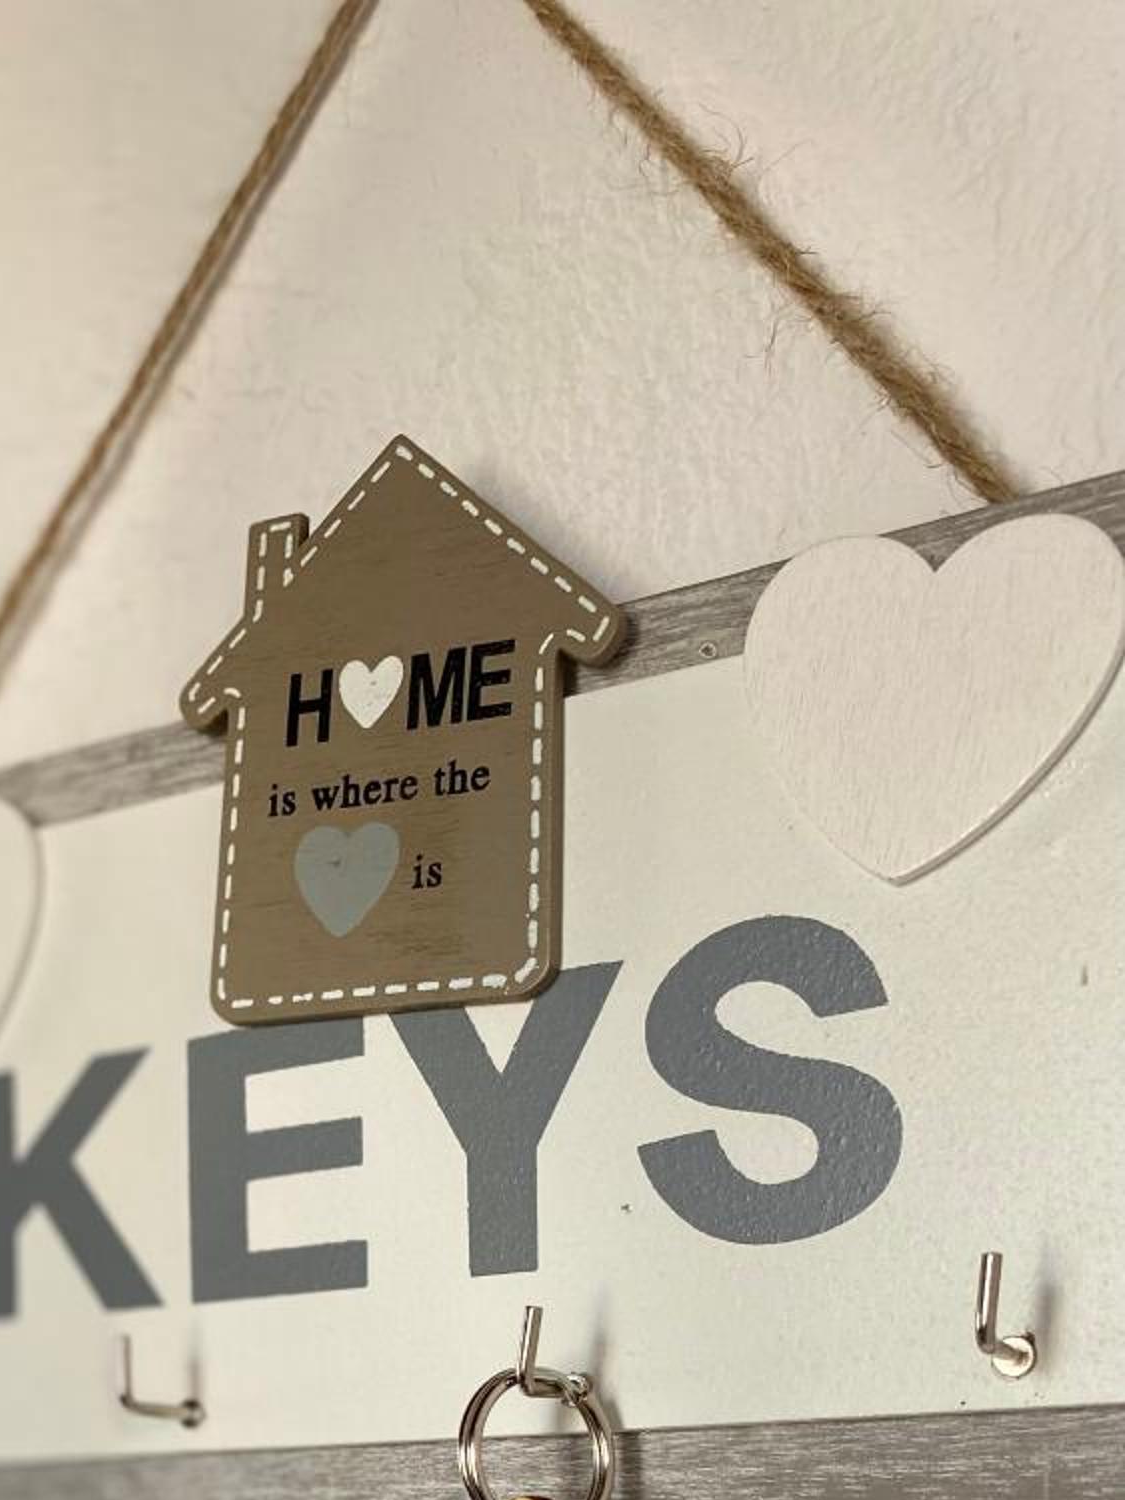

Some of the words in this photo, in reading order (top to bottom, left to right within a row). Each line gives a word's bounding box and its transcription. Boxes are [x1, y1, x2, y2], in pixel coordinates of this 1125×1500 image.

[267, 784, 297, 818] is
[311, 774, 418, 810] where
[433, 760, 492, 797] the
[410, 854, 444, 890] is
